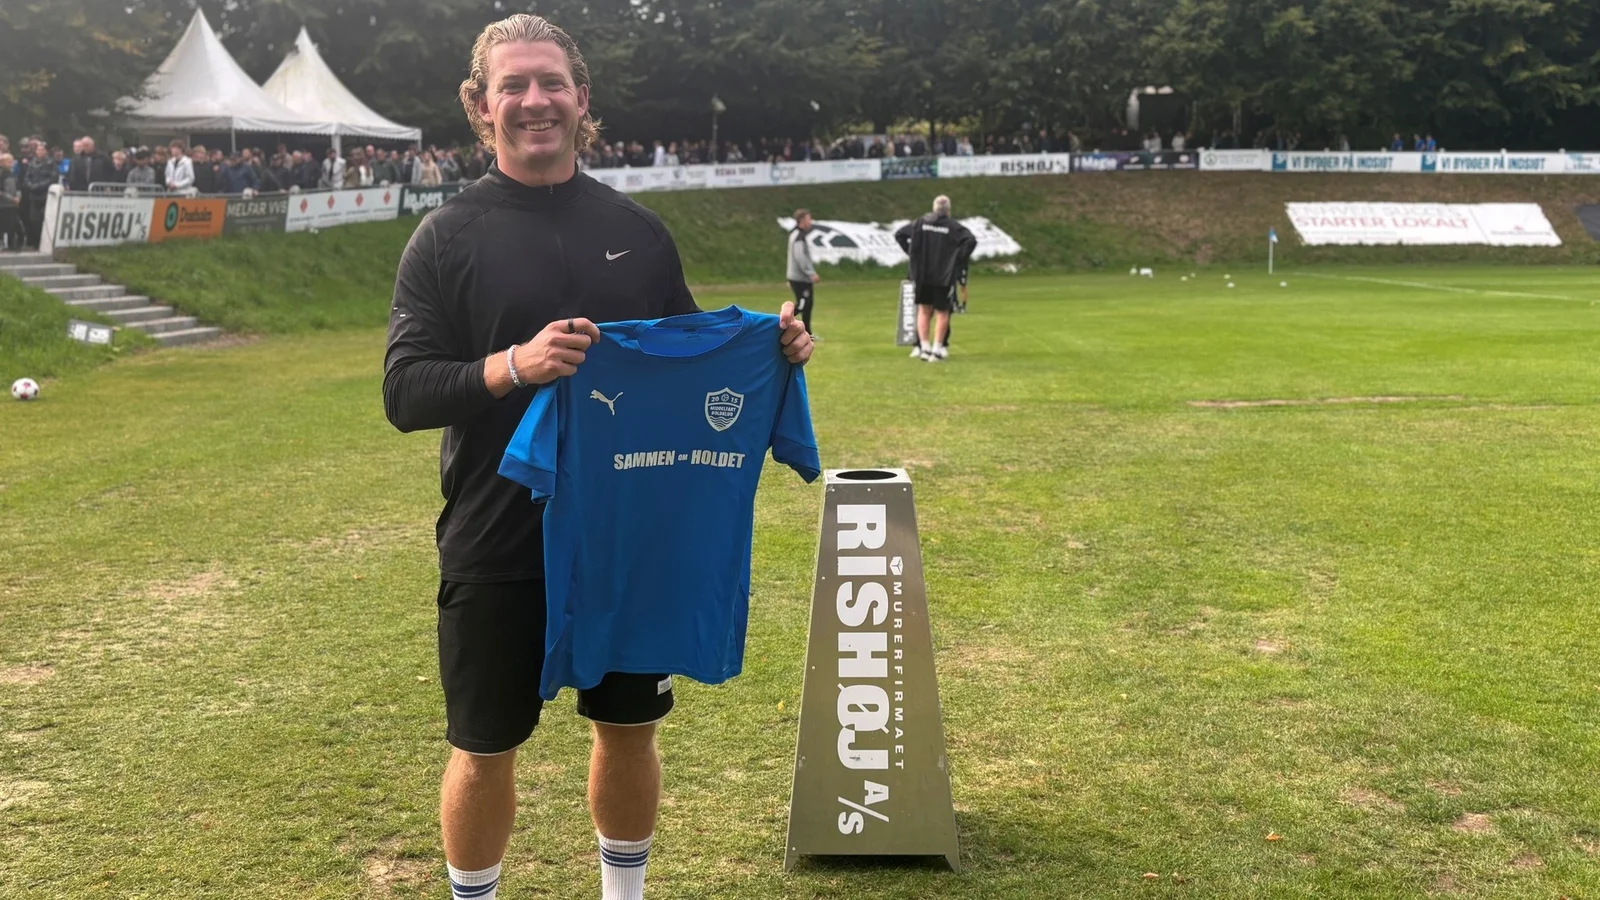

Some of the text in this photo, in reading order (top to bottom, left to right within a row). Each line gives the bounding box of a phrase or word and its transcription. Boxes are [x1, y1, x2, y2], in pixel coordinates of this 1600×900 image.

[1001, 159, 1054, 173] RISHØJ
[1292, 156, 1302, 169] VI
[1441, 156, 1451, 169] VI
[60, 211, 134, 240] RISHØJ
[1295, 216, 1470, 229] STARTER LOKALT
[613, 450, 676, 470] SAMMEN
[690, 449, 746, 469] HOLDET
[836, 504, 890, 835] RISHØJ A/S
[893, 581, 905, 770] MURERFIRMAET
